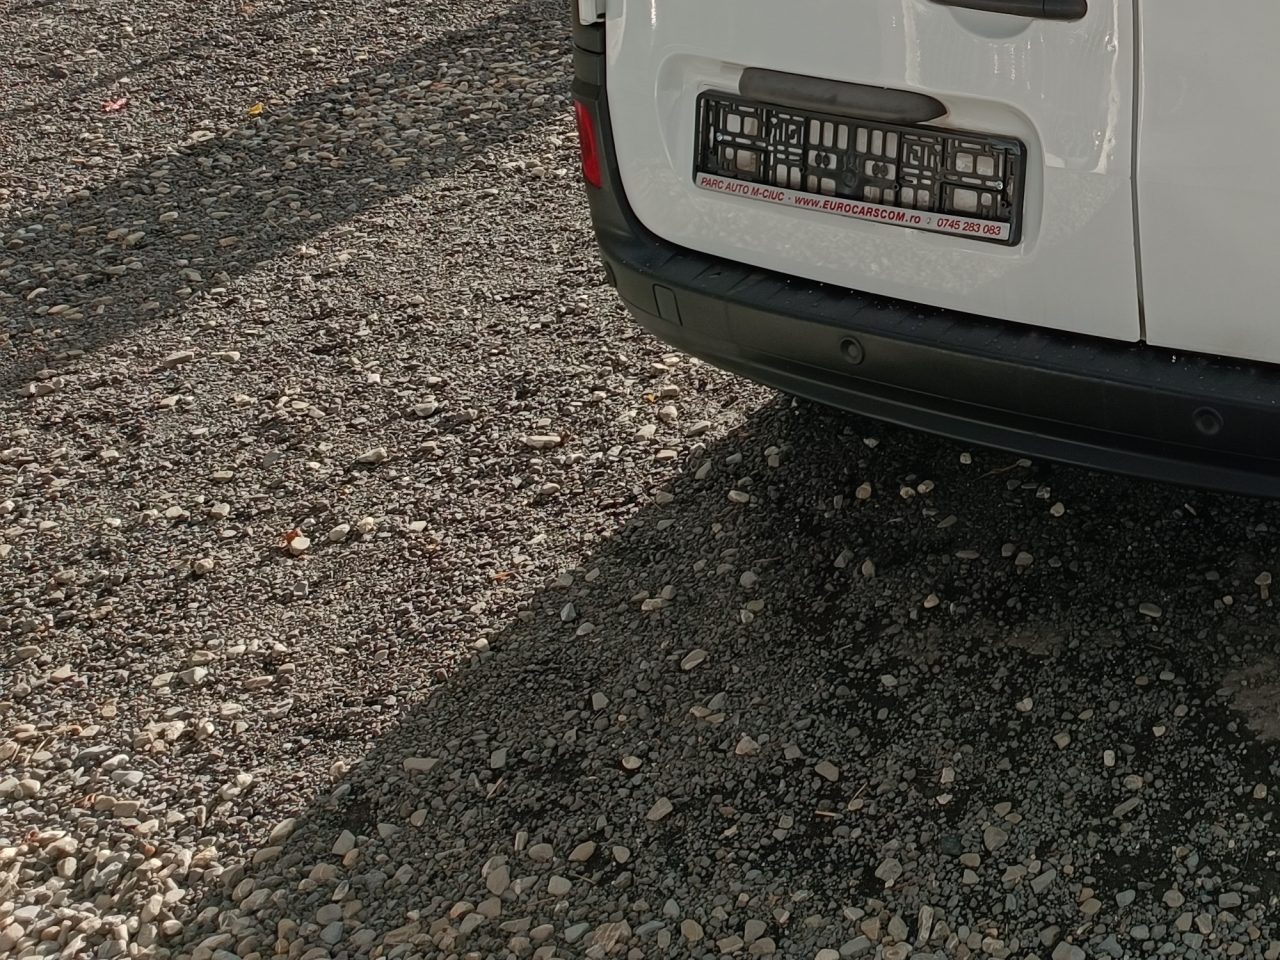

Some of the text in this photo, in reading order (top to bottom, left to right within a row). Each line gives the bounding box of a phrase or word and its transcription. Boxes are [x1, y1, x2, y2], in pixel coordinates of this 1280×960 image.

[700, 176, 724, 191] PARC
[725, 182, 749, 195] AUTO
[750, 187, 785, 202] M-CIUC
[936, 218, 960, 230] 0745
[962, 221, 981, 233] 283
[982, 224, 1002, 236] 083
